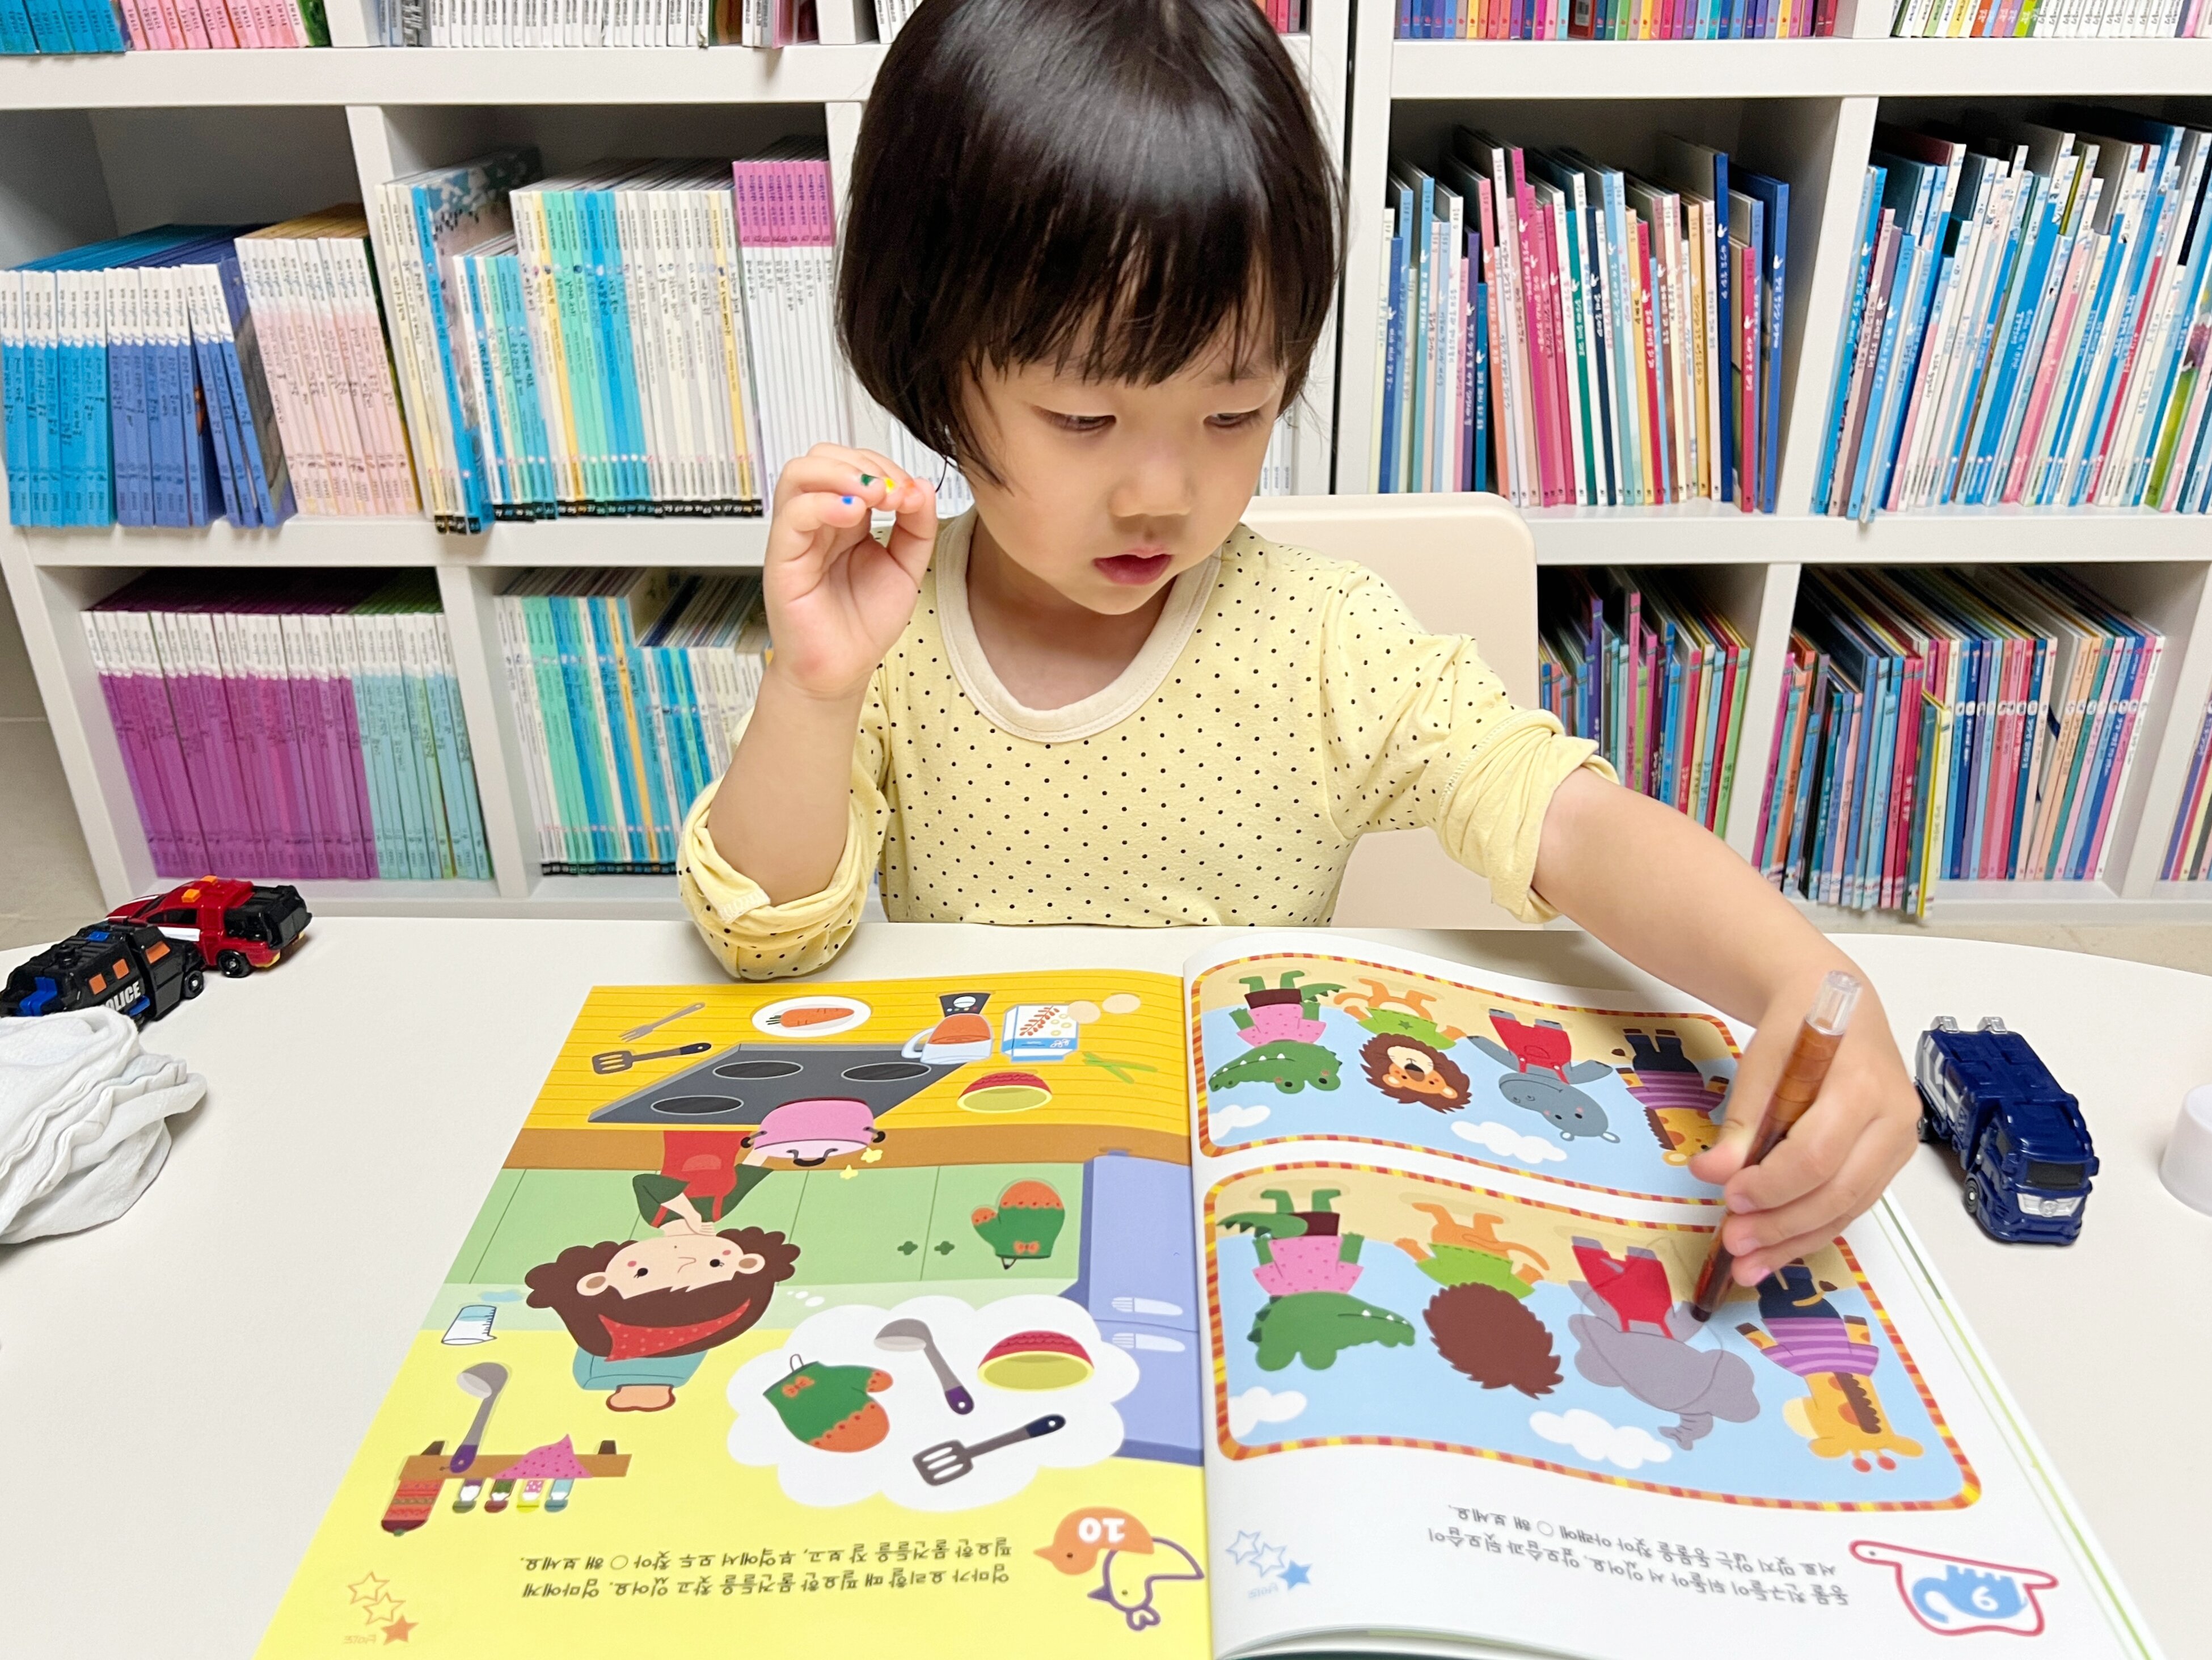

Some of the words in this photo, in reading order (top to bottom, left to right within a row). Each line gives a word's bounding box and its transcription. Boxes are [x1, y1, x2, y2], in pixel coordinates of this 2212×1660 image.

[105, 981, 141, 1011] OLICE
[1449, 1506, 1506, 1526] 보세요.
[1513, 1517, 1531, 1531] 해
[1078, 1518, 1125, 1543] 10
[1426, 1527, 1502, 1553] 뒷모습이
[1559, 1526, 1611, 1547] 아래에
[722, 1548, 796, 1567] 부엌에서
[804, 1549, 845, 1563] 보고,
[849, 1544, 867, 1564] 잘
[875, 1540, 950, 1563] 물건들을
[955, 1537, 1011, 1558] 필요한
[1507, 1540, 1579, 1568] 앞모습과
[1617, 1538, 1653, 1559] 찾아
[1657, 1542, 1710, 1569] 동물을
[520, 1557, 581, 1570] 보세요.
[588, 1557, 604, 1570] 해
[634, 1551, 671, 1570] 찾아
[679, 1554, 716, 1567] 모두
[1585, 1556, 1643, 1580] 있어요.
[1716, 1552, 1754, 1573] 않는
[1758, 1557, 1795, 1576] 맞지
[1800, 1563, 1835, 1576] 서로
[720, 1573, 796, 1596] 물건들을
[801, 1570, 858, 1592] 필요한
[864, 1573, 883, 1587] 때
[889, 1568, 947, 1589] 요리할
[952, 1564, 1009, 1584] 엄마가
[1649, 1569, 1664, 1583] 서
[1671, 1572, 1725, 1594] 뒤돌아
[522, 1578, 600, 1599] 엄마에게
[609, 1577, 669, 1597] 있어요.
[677, 1575, 712, 1596] 찾고
[1730, 1580, 1805, 1604] 친구들이
[1810, 1585, 1848, 1606] 동물
[1972, 1586, 1998, 1611] 9
